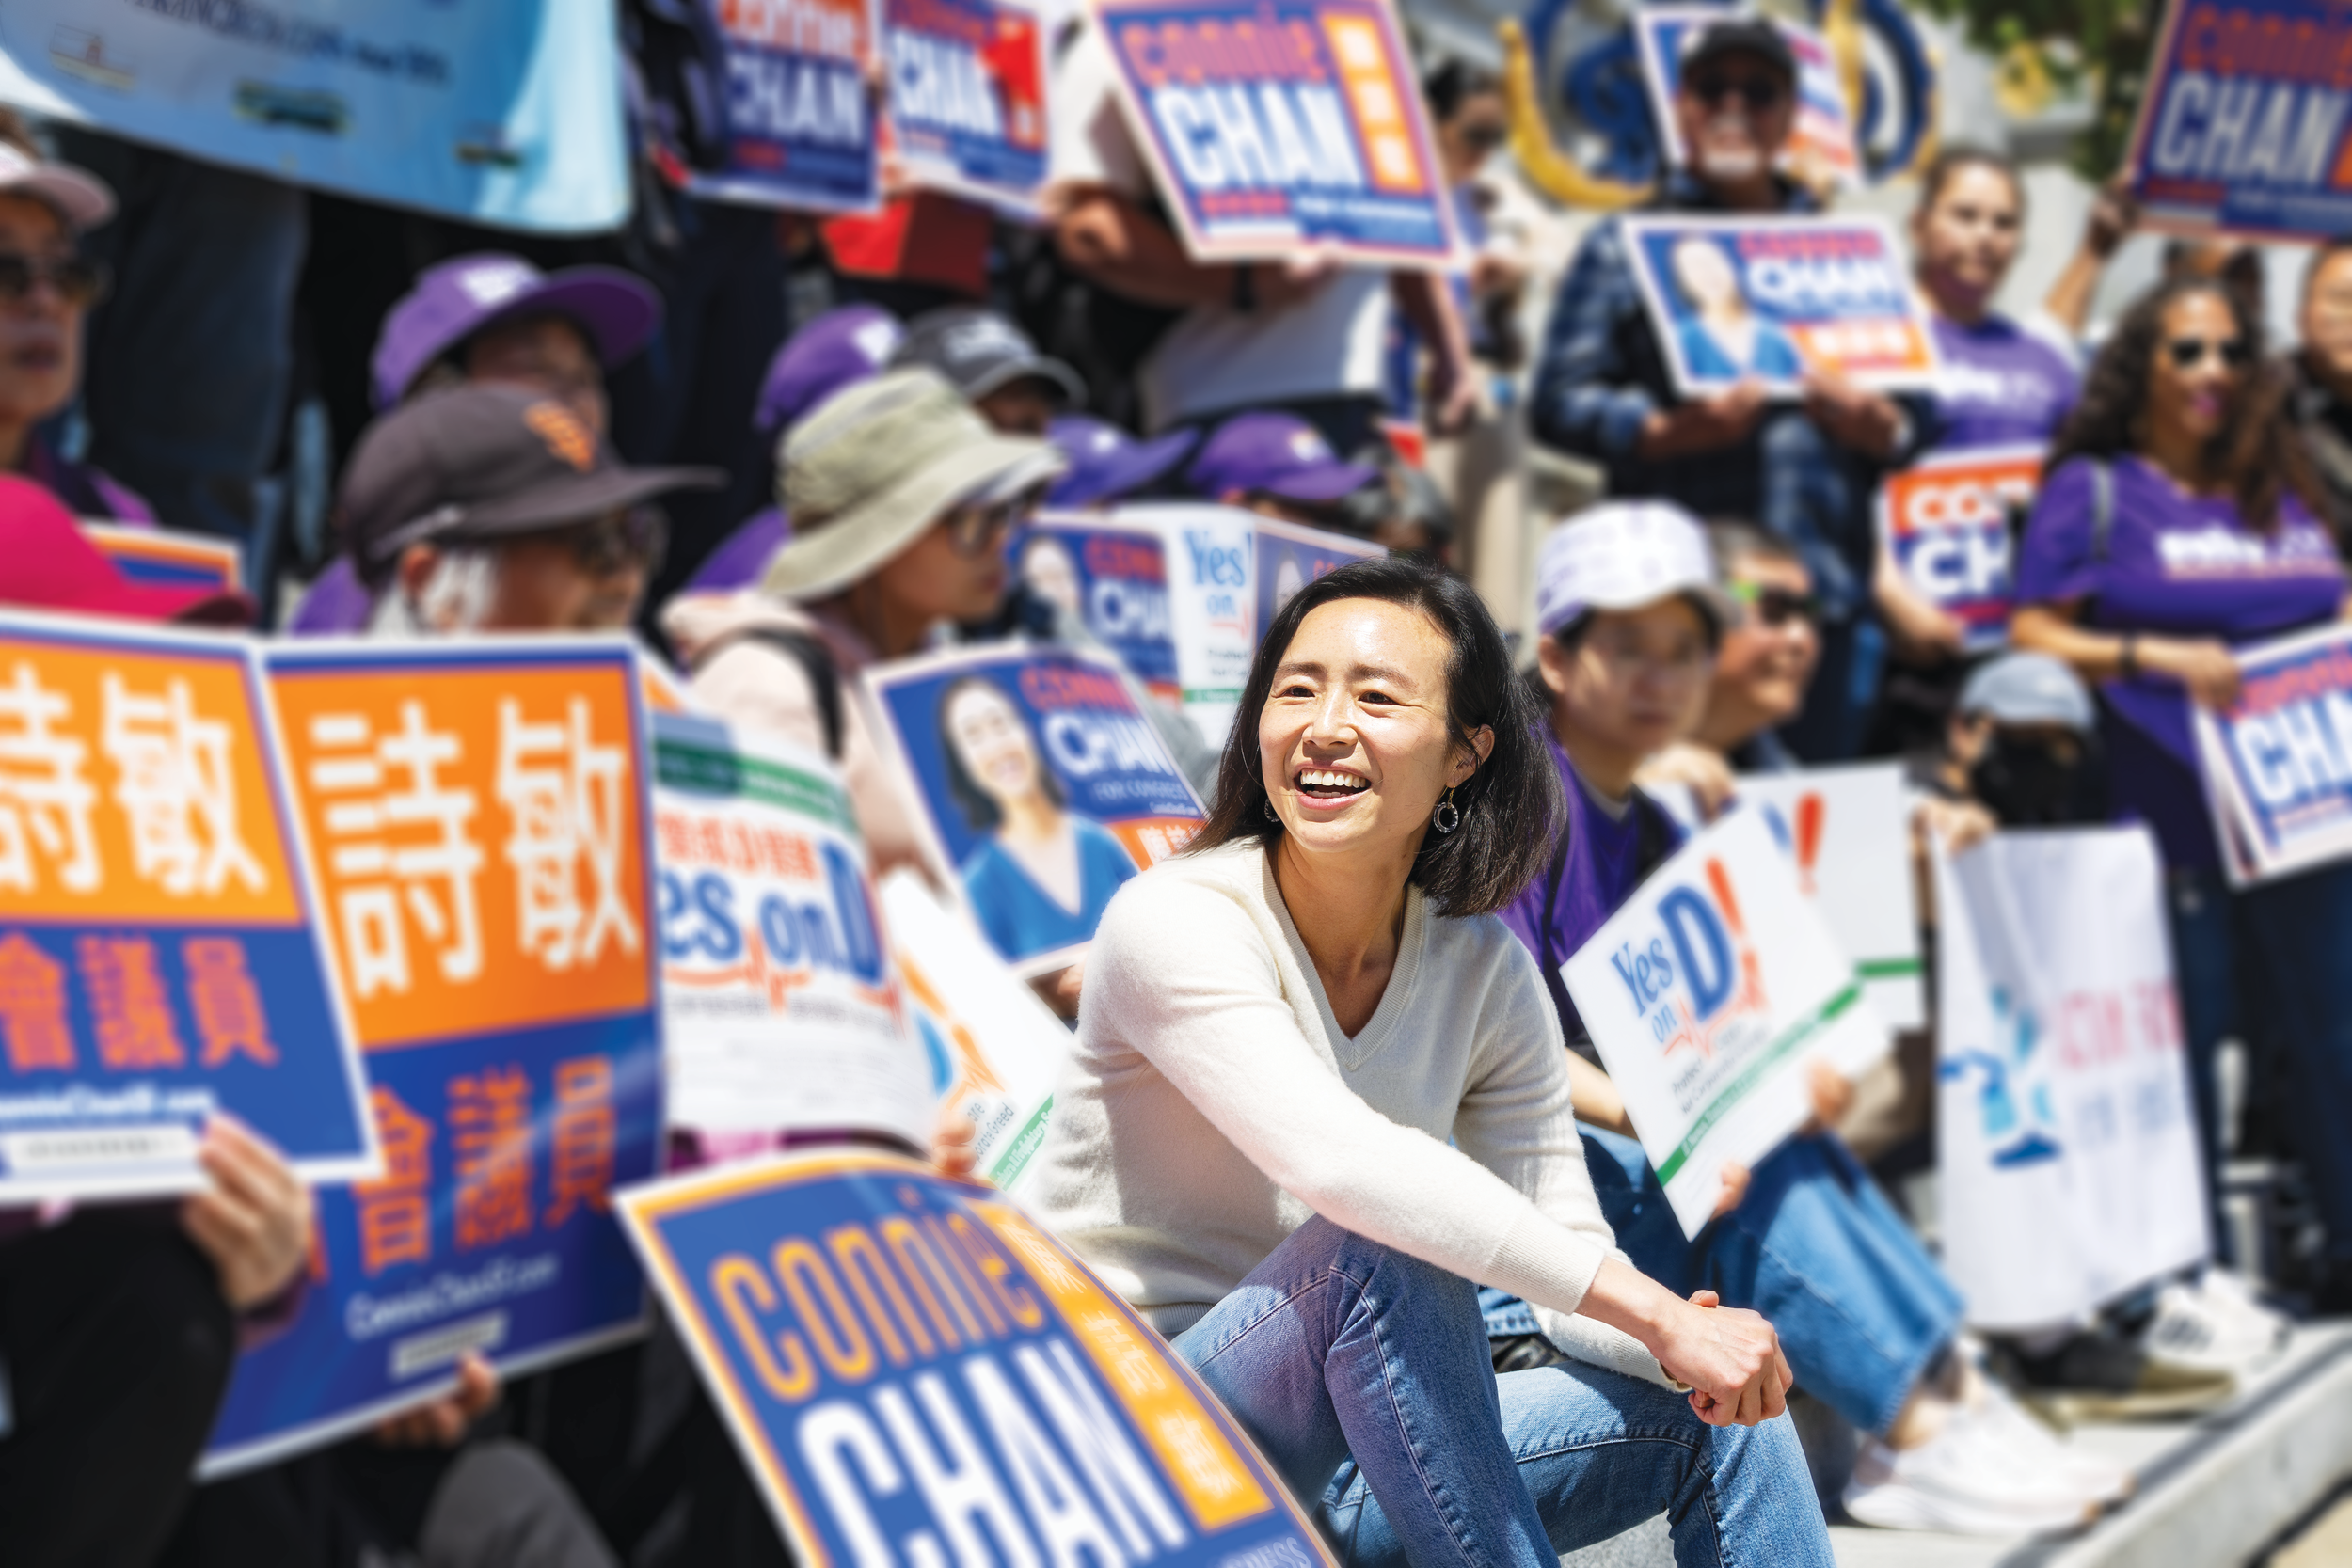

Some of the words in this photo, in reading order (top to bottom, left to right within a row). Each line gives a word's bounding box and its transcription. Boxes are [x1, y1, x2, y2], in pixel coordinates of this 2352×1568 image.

[1152, 83, 1362, 186] CHAN
[2154, 73, 2349, 183] CHAN
[1182, 528, 1247, 587] Yes
[1206, 595, 1235, 617] on
[1044, 713, 1175, 776] CHAN
[1093, 780, 1127, 801] FOR
[1127, 779, 1189, 801] CONGRESS
[309, 697, 642, 999] 詩敏
[659, 868, 744, 966] es
[758, 893, 847, 974] on
[1611, 938, 1673, 1018] Yes
[1652, 1004, 1677, 1043] on
[967, 1102, 986, 1123] are
[986, 1101, 1015, 1135] Greed
[709, 1181, 1044, 1403] connie
[795, 1336, 1187, 1568] CHAN
